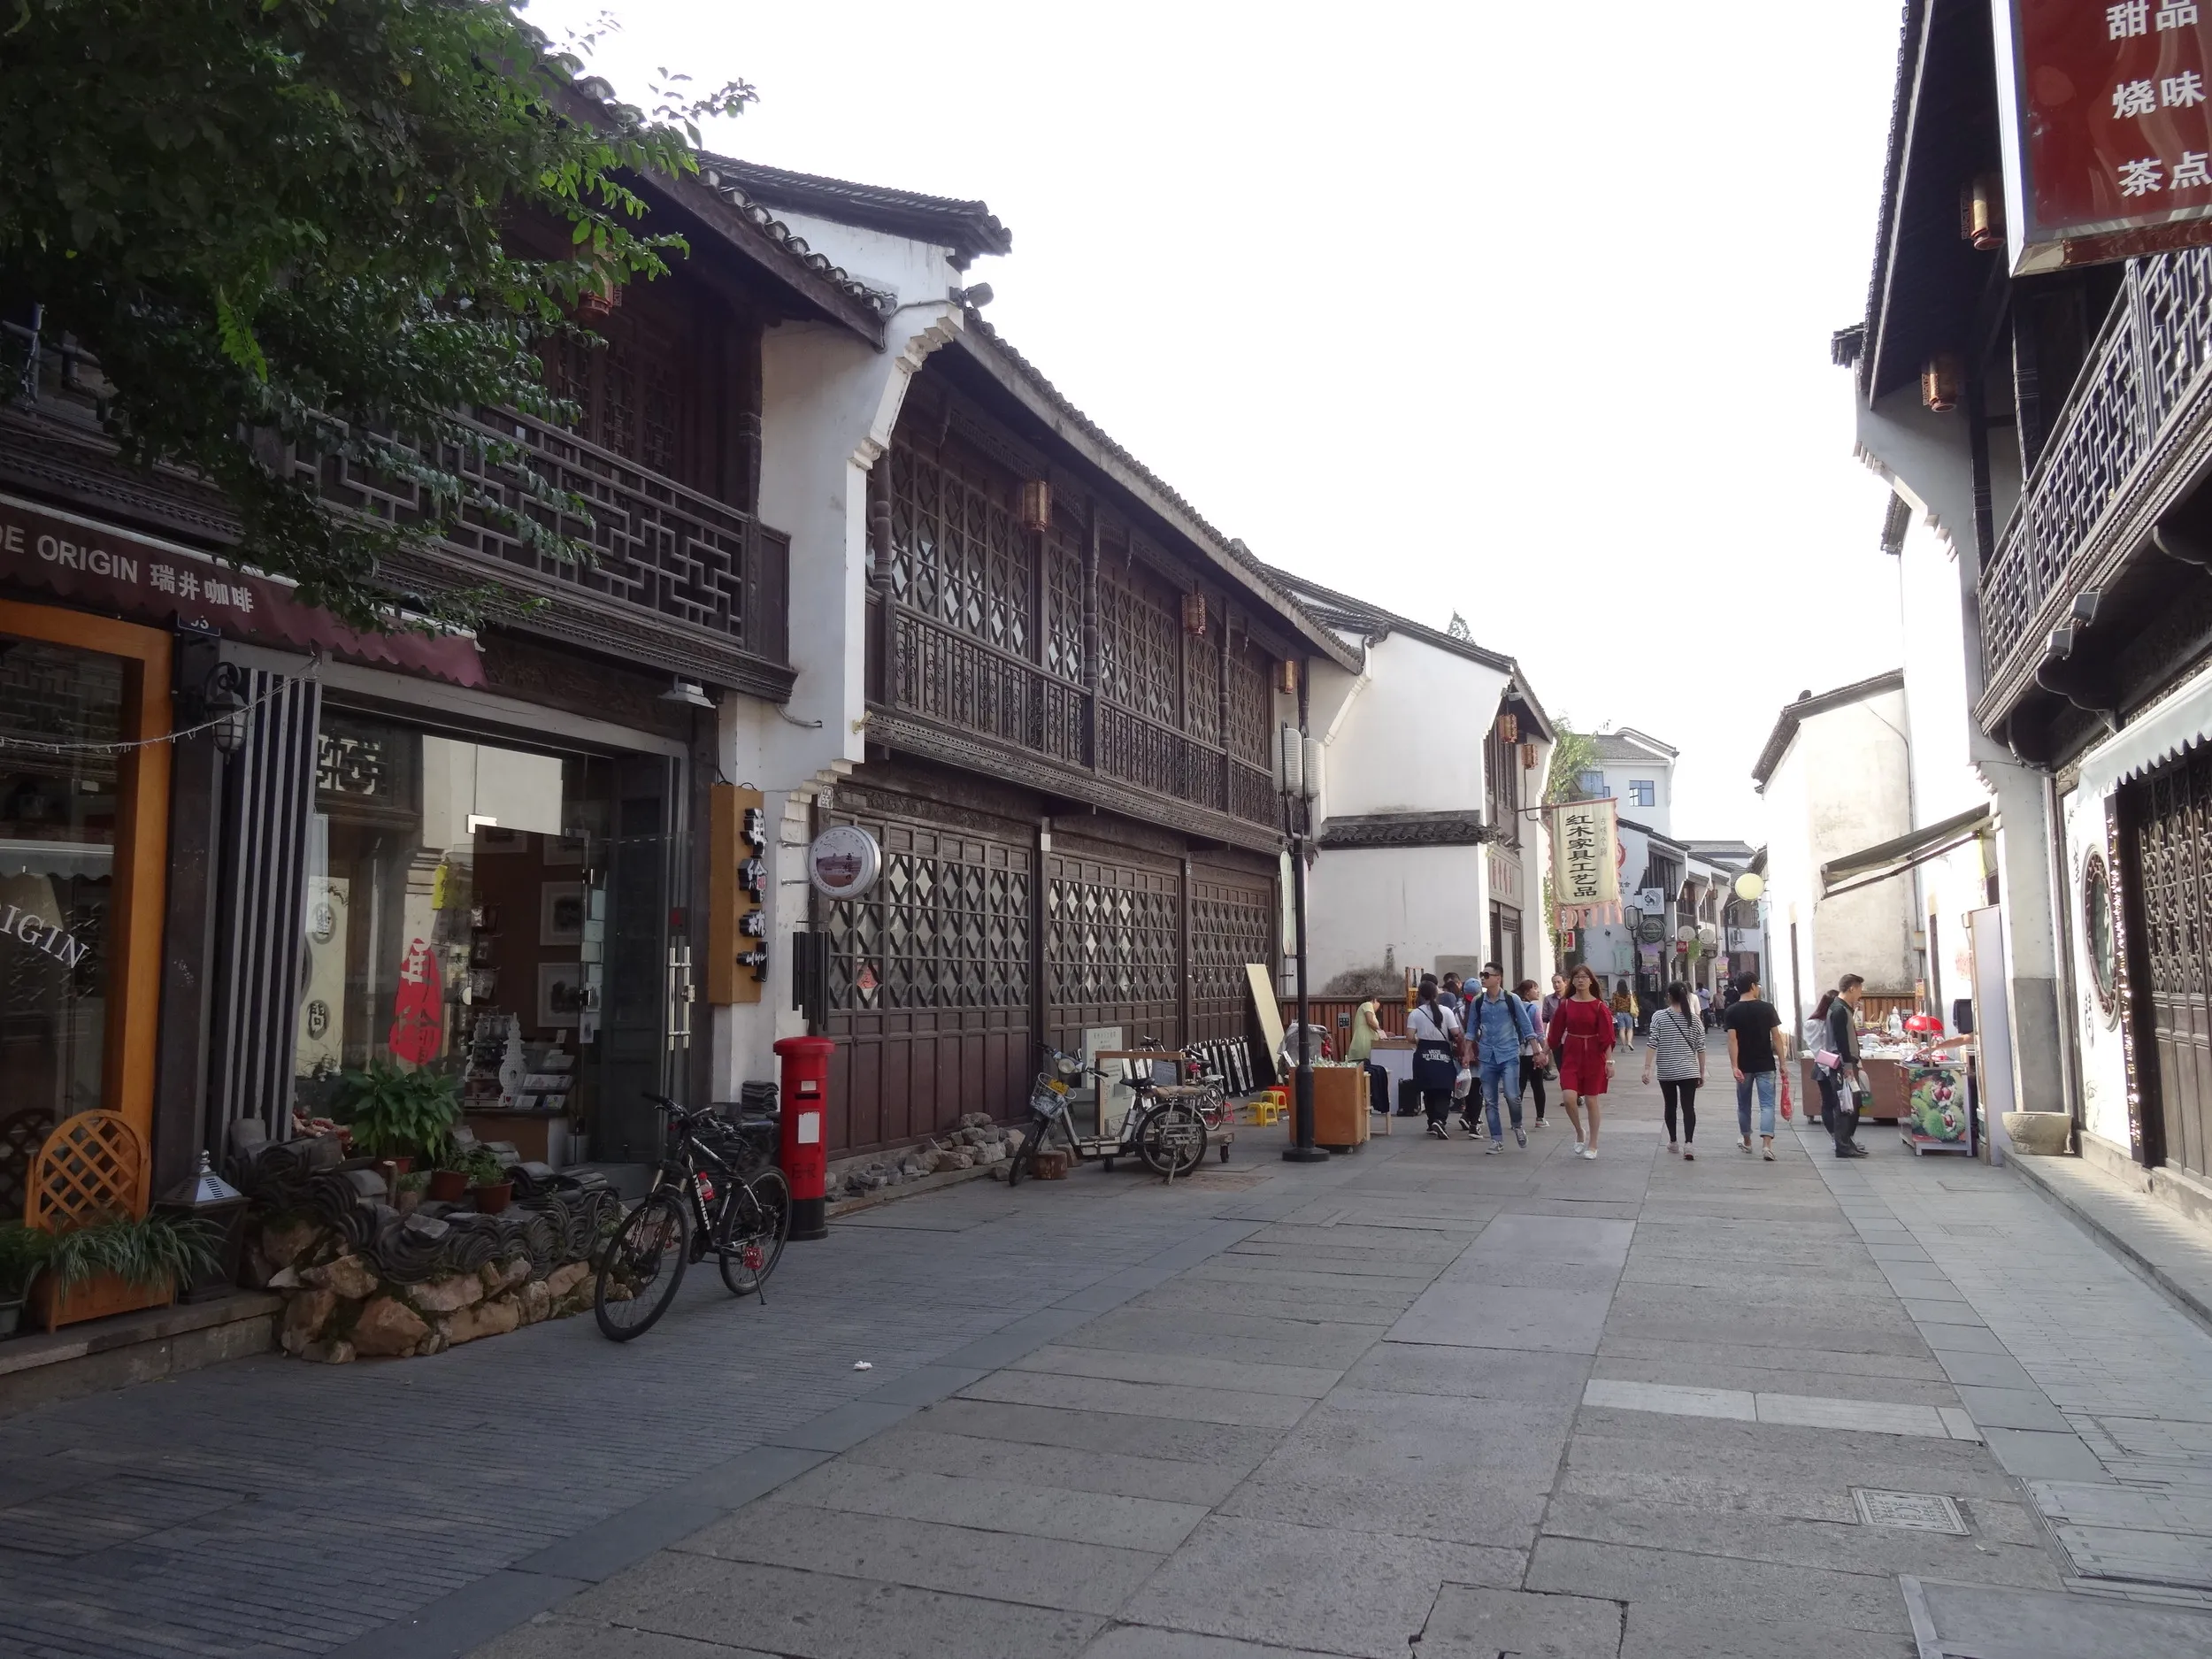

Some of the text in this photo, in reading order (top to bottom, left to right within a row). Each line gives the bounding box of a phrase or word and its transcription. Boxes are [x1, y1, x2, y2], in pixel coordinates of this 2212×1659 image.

[2107, 0, 2198, 41] 甜品
[2112, 71, 2207, 119] 烧味
[2117, 151, 2212, 197] 茶点
[0, 525, 254, 613] E ORIGIN 瑞井咖啡
[1566, 814, 1596, 896] 红木家具工艺品
